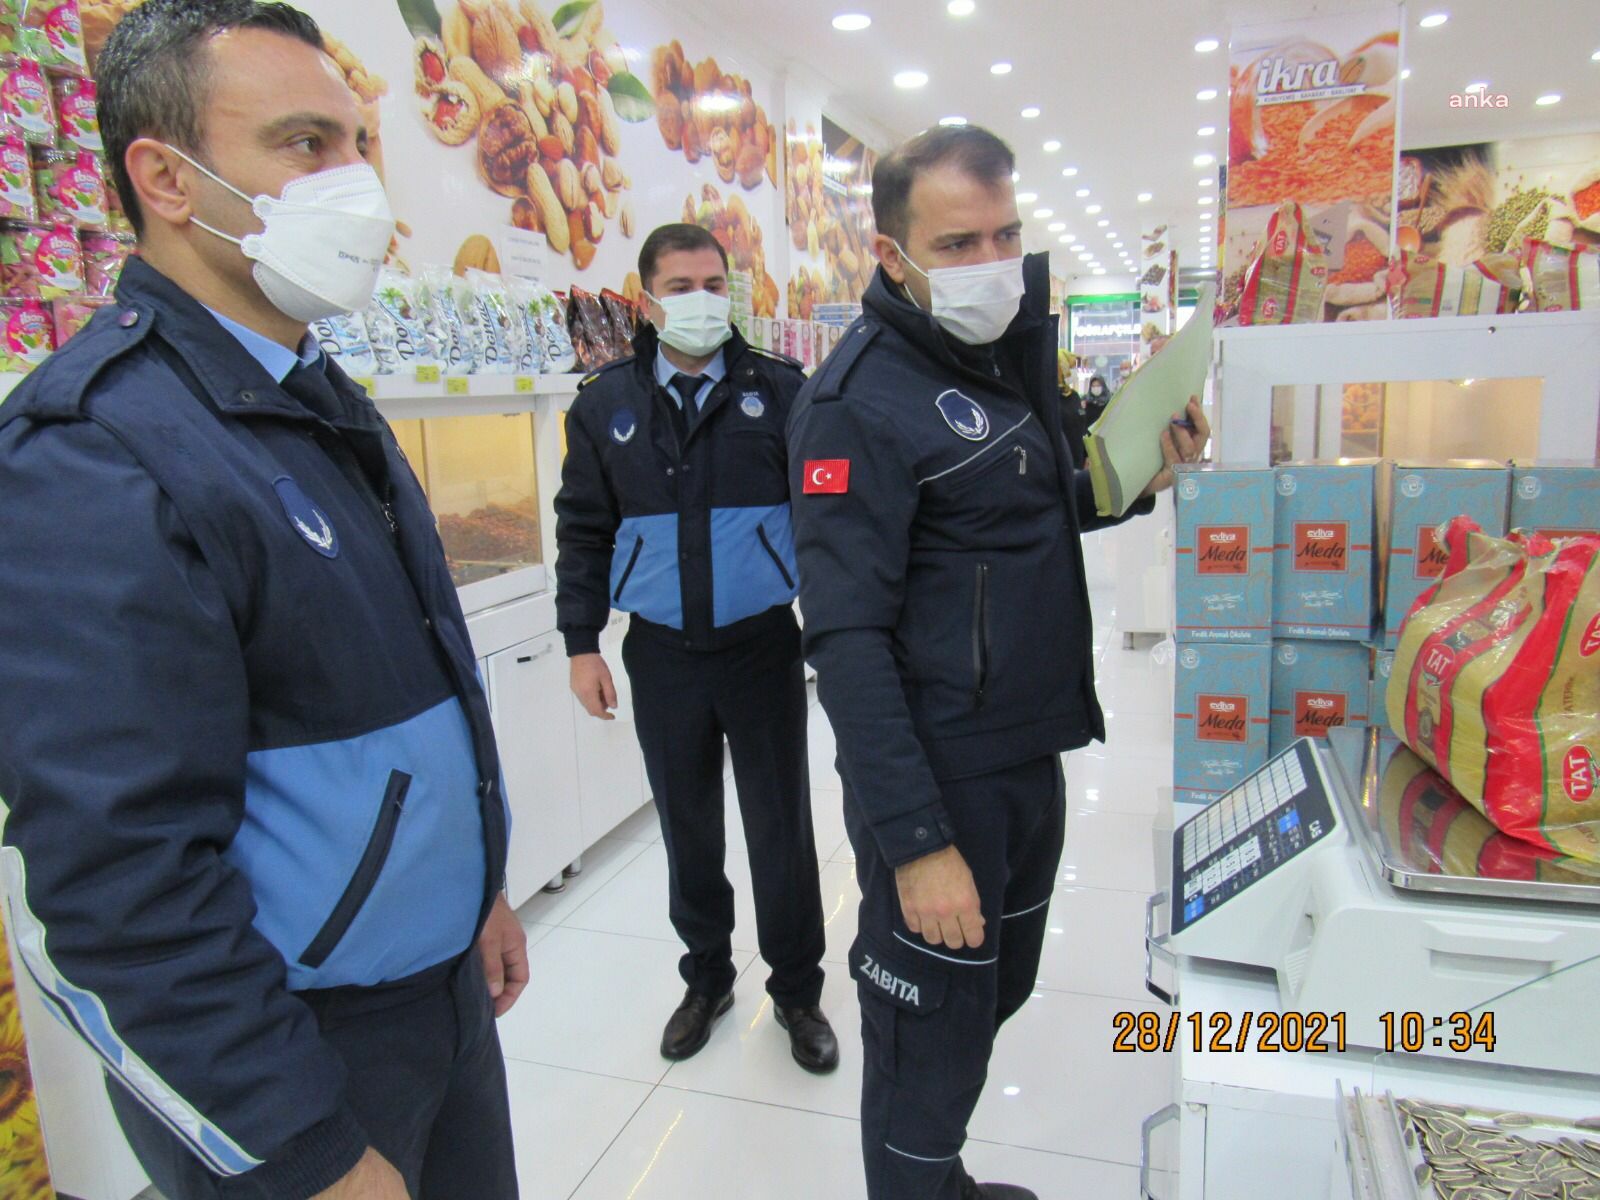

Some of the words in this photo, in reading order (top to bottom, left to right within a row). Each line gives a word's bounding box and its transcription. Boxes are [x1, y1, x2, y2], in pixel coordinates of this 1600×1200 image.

[1257, 58, 1338, 94] ikra
[1200, 545, 1247, 561] Meda
[1297, 541, 1345, 559] Meda
[1420, 546, 1449, 564] Me
[1426, 648, 1450, 675] TAT
[1200, 712, 1246, 730] Meda
[1297, 709, 1344, 726] Meda
[1569, 755, 1587, 795] TAT
[859, 954, 920, 1006] ZABITA
